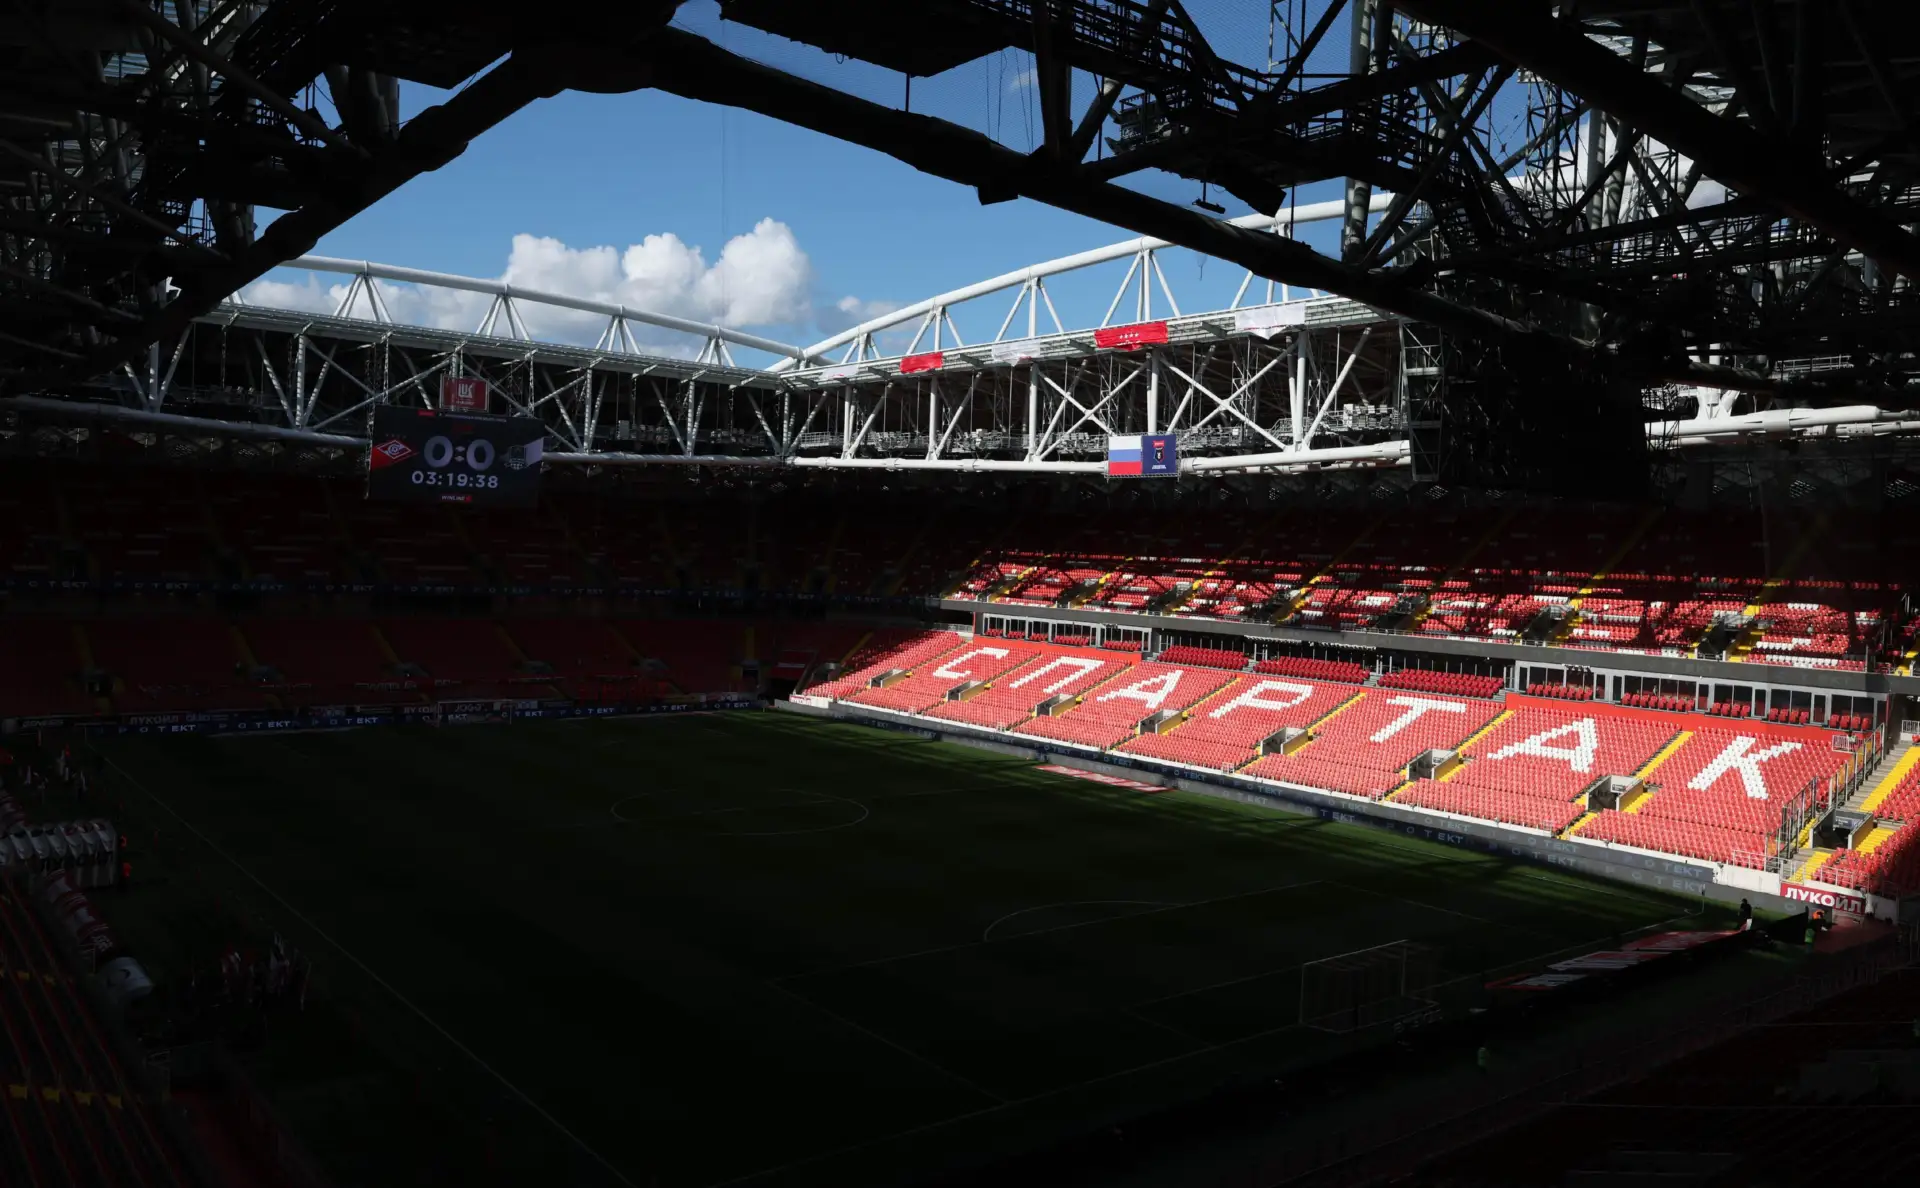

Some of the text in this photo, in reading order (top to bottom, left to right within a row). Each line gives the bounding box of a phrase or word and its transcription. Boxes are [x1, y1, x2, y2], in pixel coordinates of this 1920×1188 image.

[423, 435, 496, 472] 0:0
[411, 470, 499, 489] 03:19:38
[932, 646, 1803, 801] СПАРТАК
[1784, 886, 1862, 913] ЛУКОЙЛ
